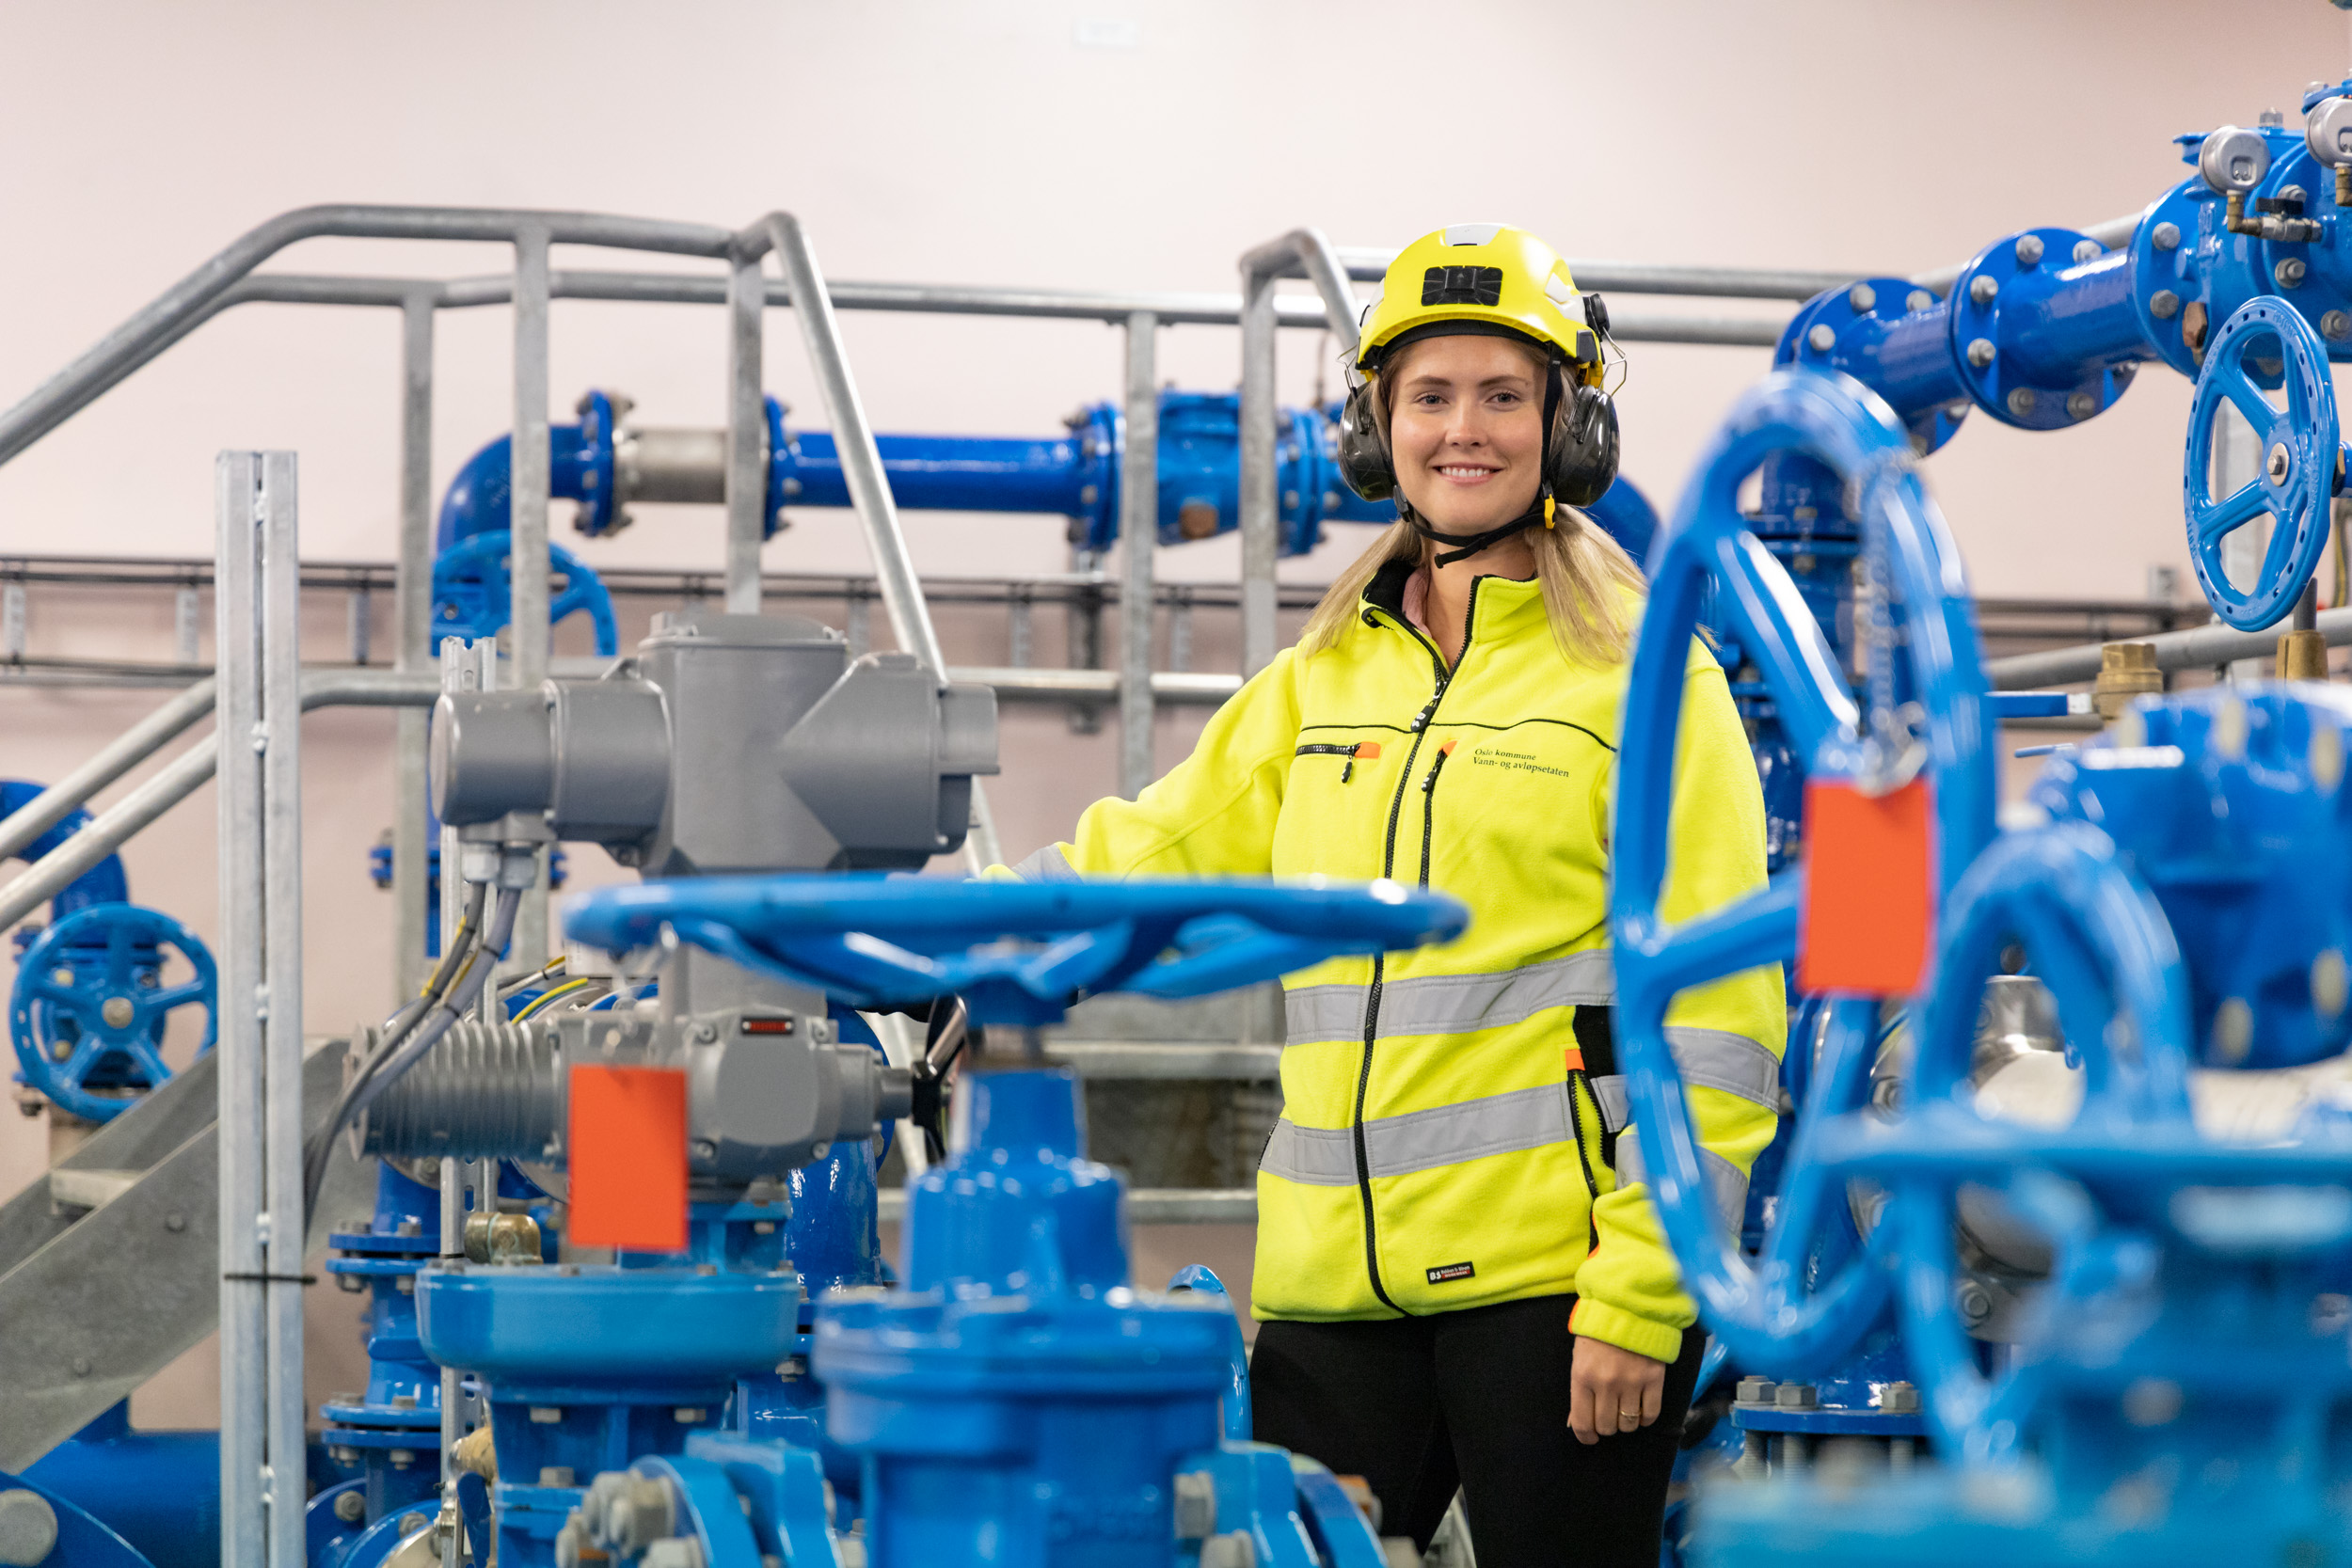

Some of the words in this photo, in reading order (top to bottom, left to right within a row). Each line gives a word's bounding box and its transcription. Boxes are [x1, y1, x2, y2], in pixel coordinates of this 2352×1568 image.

[1474, 748, 1494, 756] Oslo
[1495, 749, 1536, 761] kommune
[1473, 756, 1498, 767] Vann-
[1500, 761, 1511, 769] og
[1513, 761, 1570, 778] avløpsetaten
